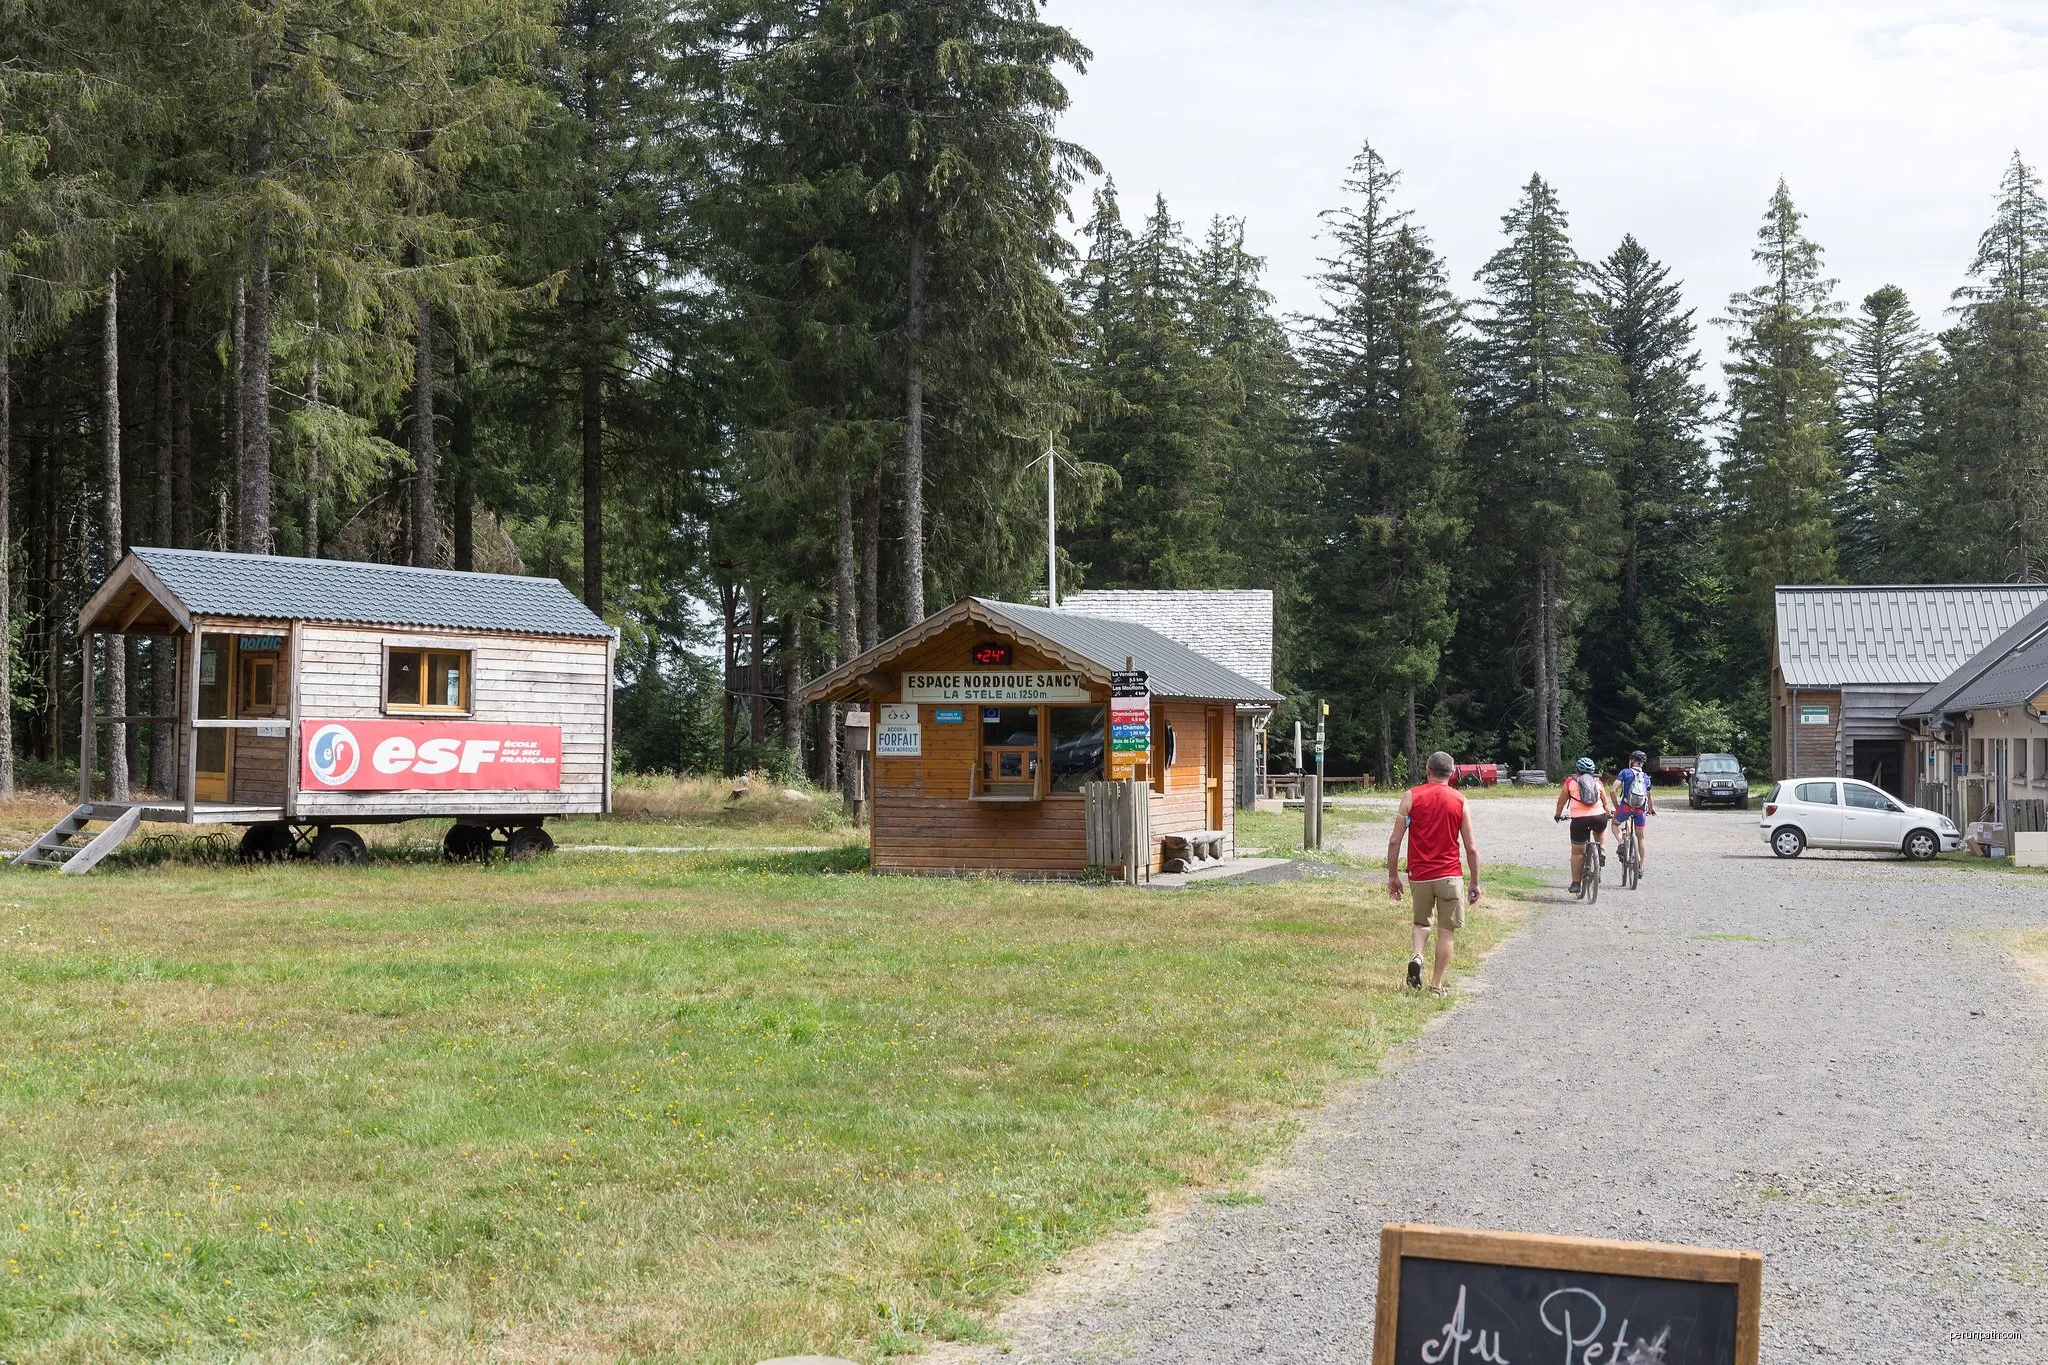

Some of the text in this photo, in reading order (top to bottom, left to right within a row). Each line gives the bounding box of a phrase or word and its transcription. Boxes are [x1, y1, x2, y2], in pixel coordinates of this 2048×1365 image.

[240, 637, 282, 650] nordic
[908, 674, 1081, 688] ESPACE NORDIQUE SANCY
[944, 690, 959, 699] LA
[878, 733, 918, 746] FORFAIT
[521, 749, 541, 757] SKI
[499, 756, 557, 764] FRANÇAIS
[1421, 1284, 1510, 1364] Au
